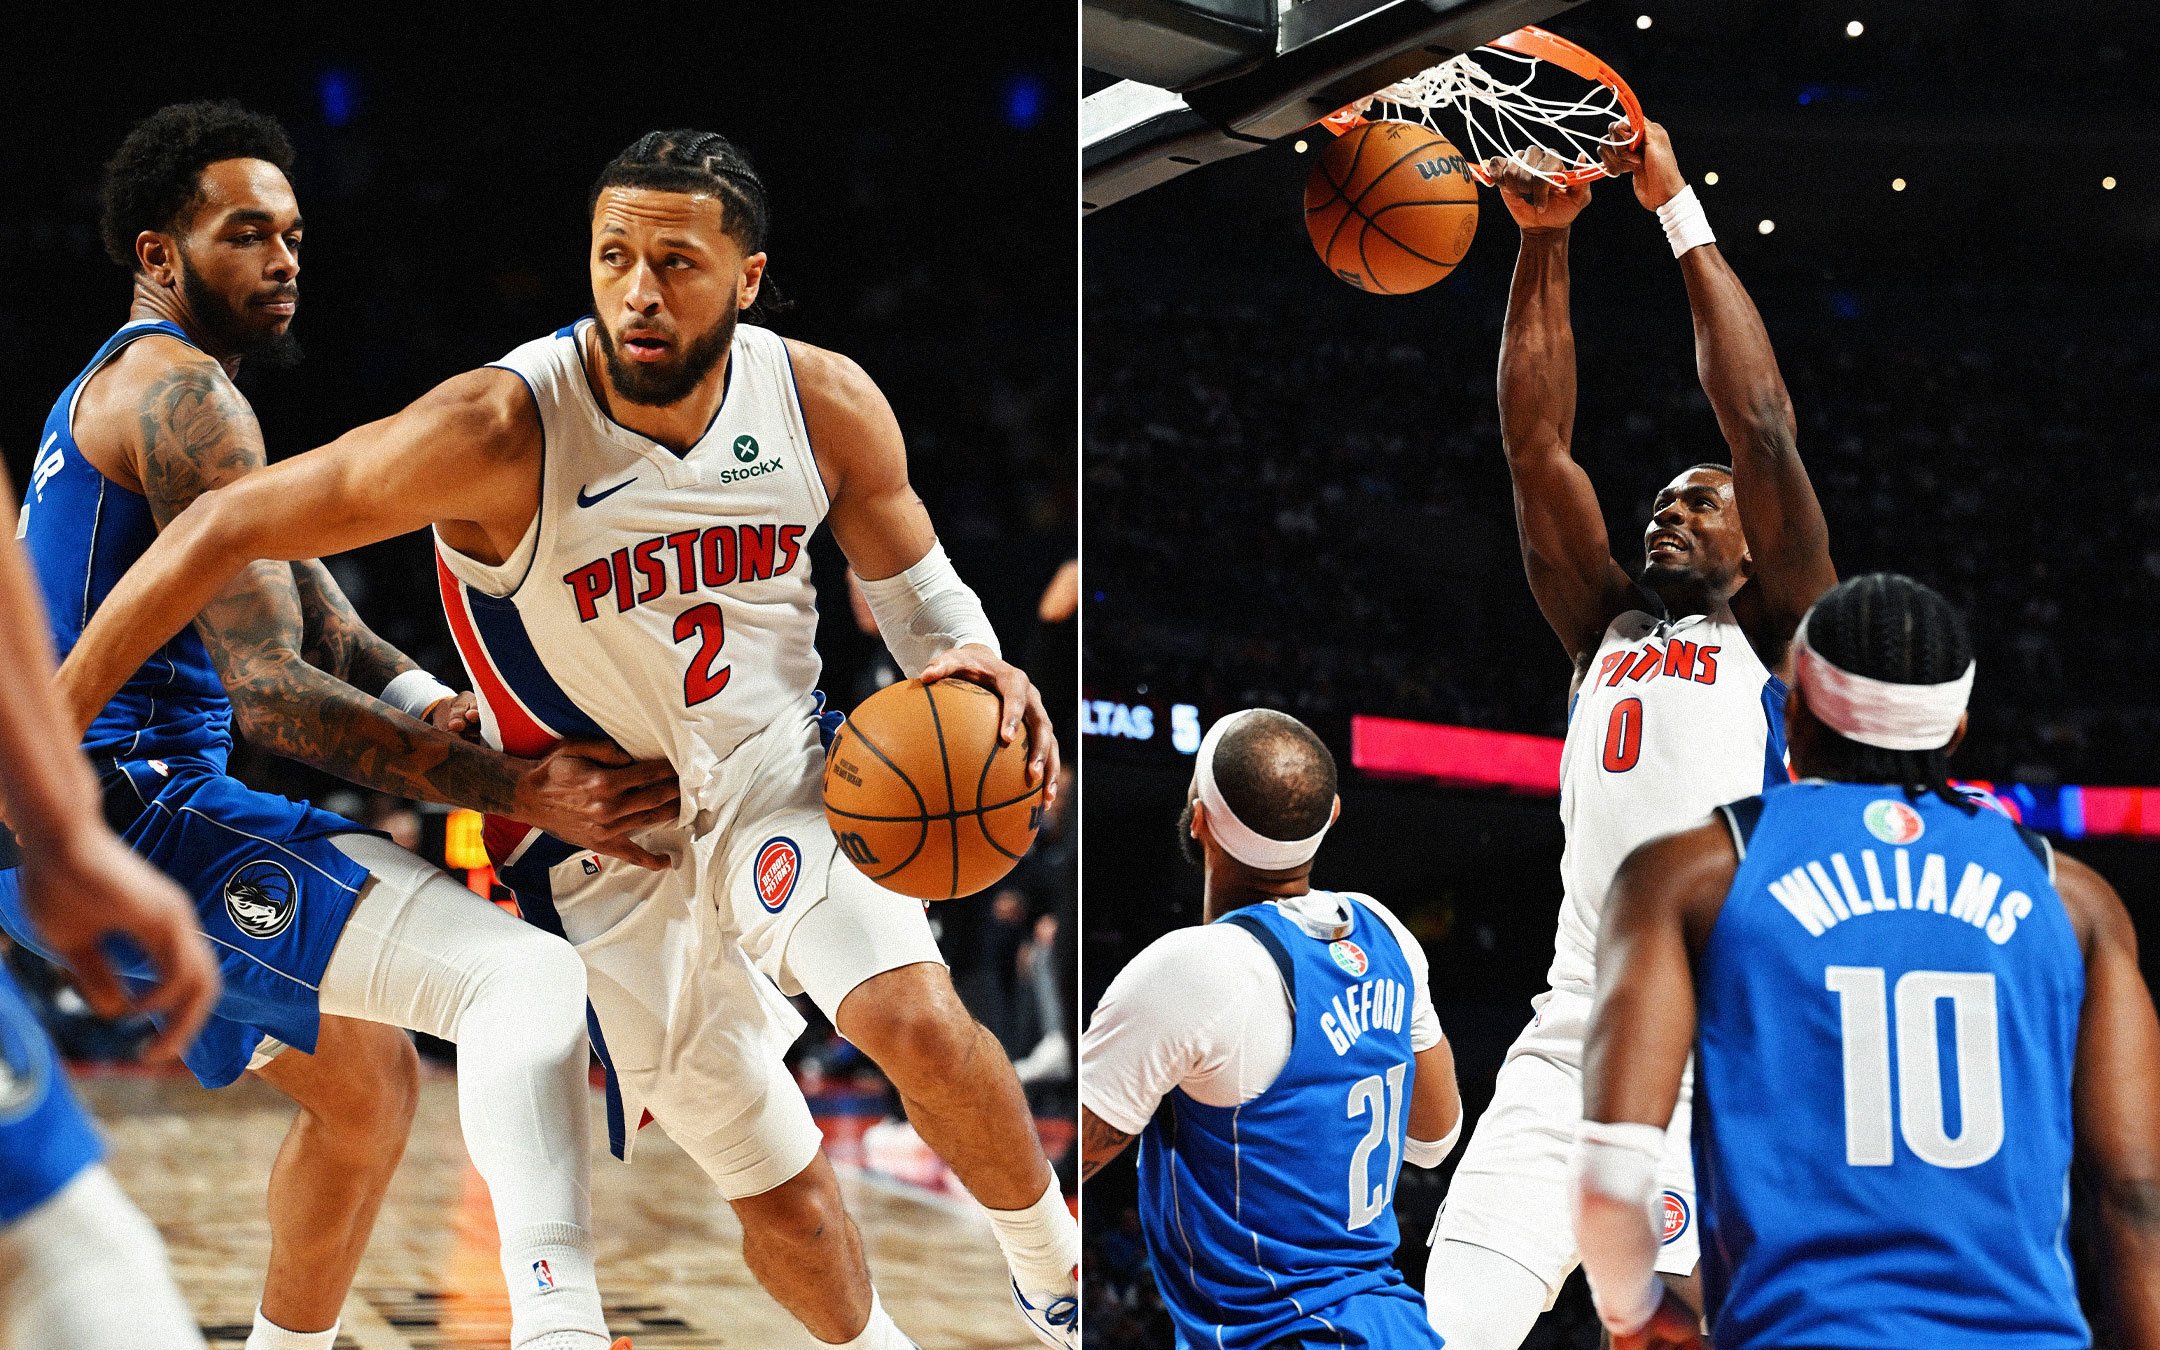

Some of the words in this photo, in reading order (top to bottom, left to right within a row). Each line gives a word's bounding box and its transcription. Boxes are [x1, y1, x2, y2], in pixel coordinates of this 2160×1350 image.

[720, 457, 783, 484] StockX
[563, 524, 806, 623] PISTONS
[673, 602, 730, 708] 2
[1171, 704, 1201, 755] 5
[1603, 697, 1643, 773] 0
[761, 852, 787, 886] DETROIT
[766, 862, 791, 897] PISTONS
[1767, 848, 2033, 945] WILLIAMS
[1320, 978, 1406, 1056] GAFFORD
[1825, 965, 2005, 1169] 10
[1347, 1062, 1407, 1231] 21
